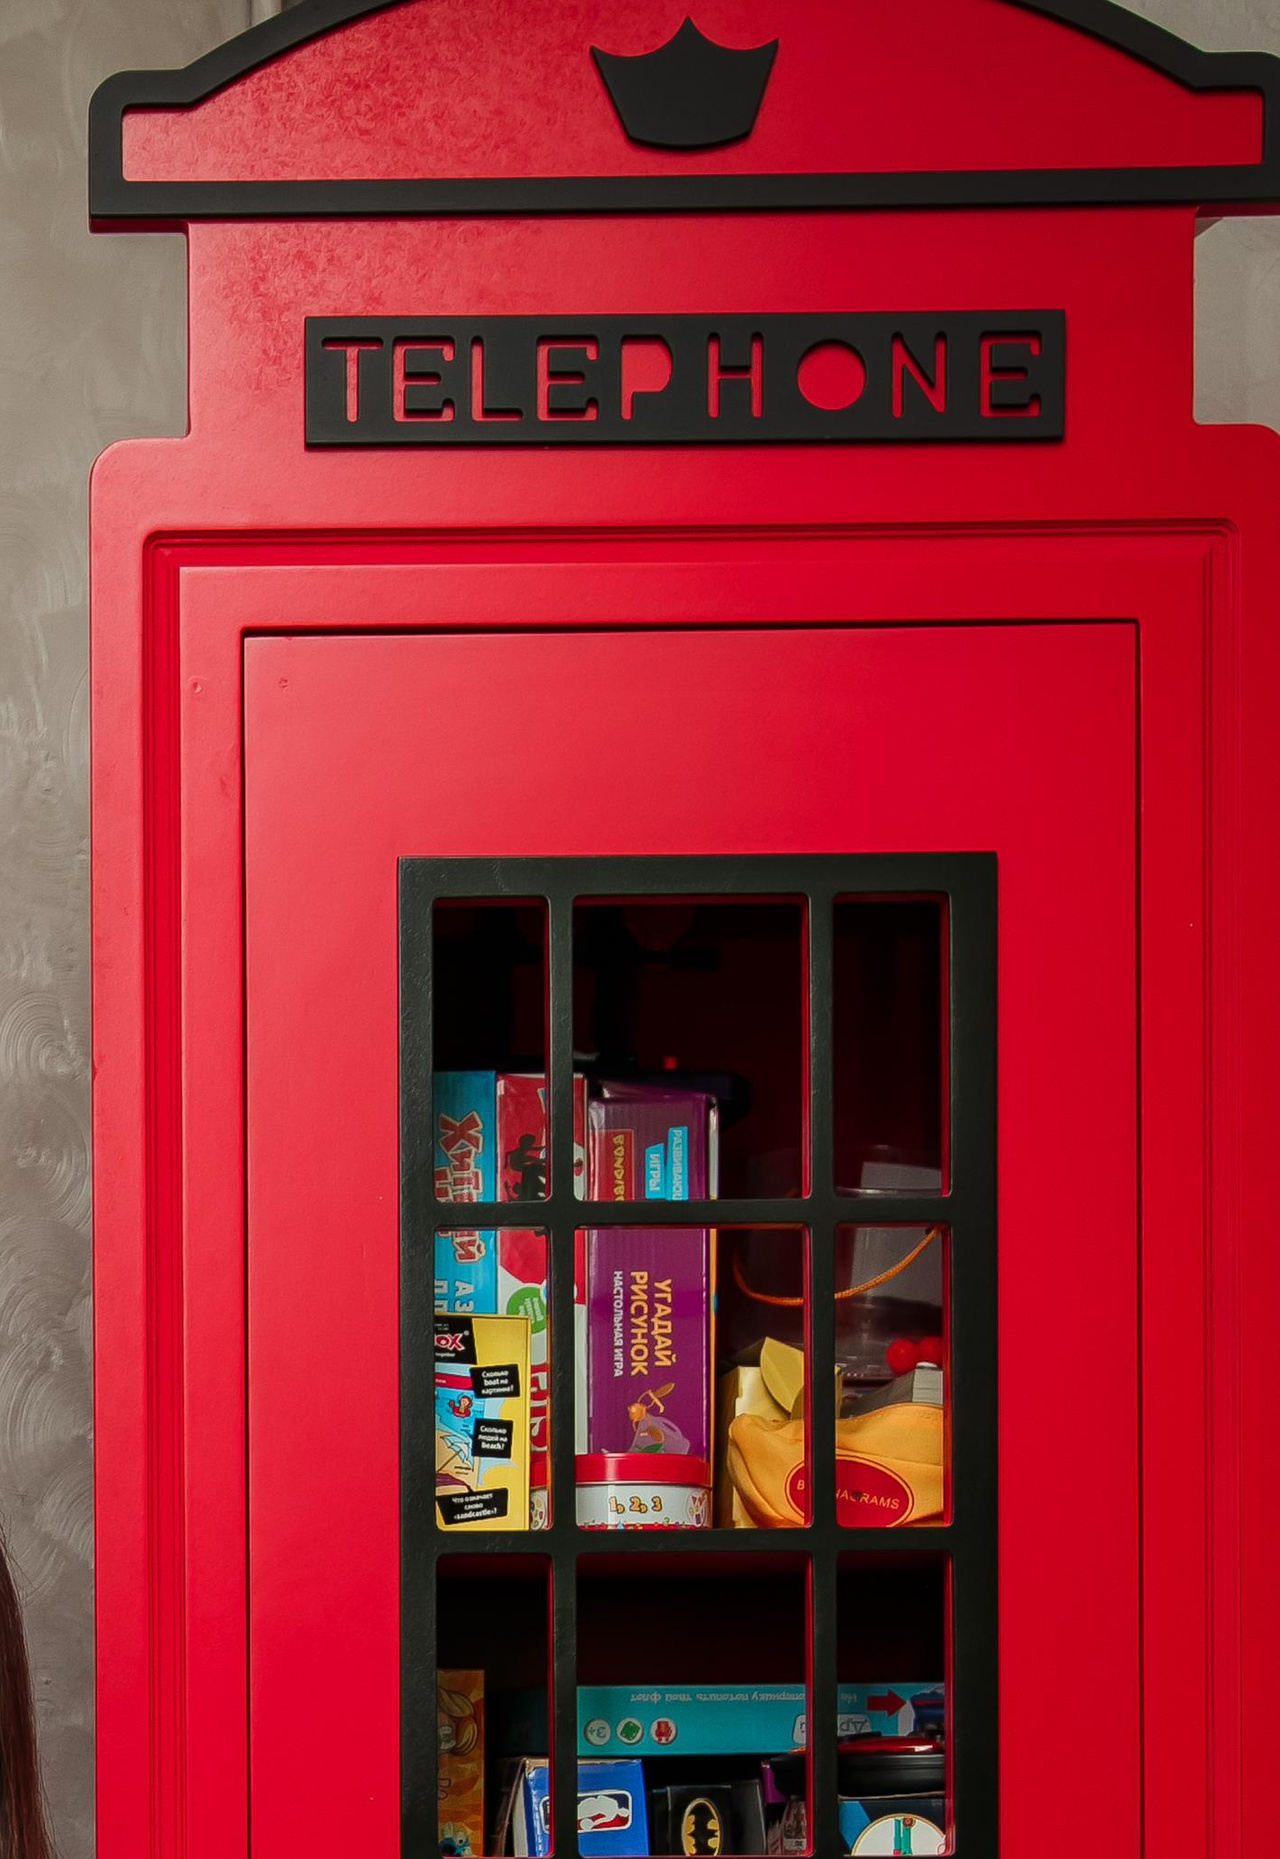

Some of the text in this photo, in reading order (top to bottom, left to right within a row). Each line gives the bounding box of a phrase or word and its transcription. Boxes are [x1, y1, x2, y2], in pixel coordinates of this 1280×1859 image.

[320, 330, 1043, 423] TELEPHONE
[648, 1153, 661, 1192] ИГРЫ
[613, 1270, 624, 1378] НАСТОЛЬНАЯ ИГРА
[629, 1270, 649, 1377] РИСУНОК
[650, 1278, 677, 1367] УГАДАЙ
[651, 1495, 663, 1512] 3
